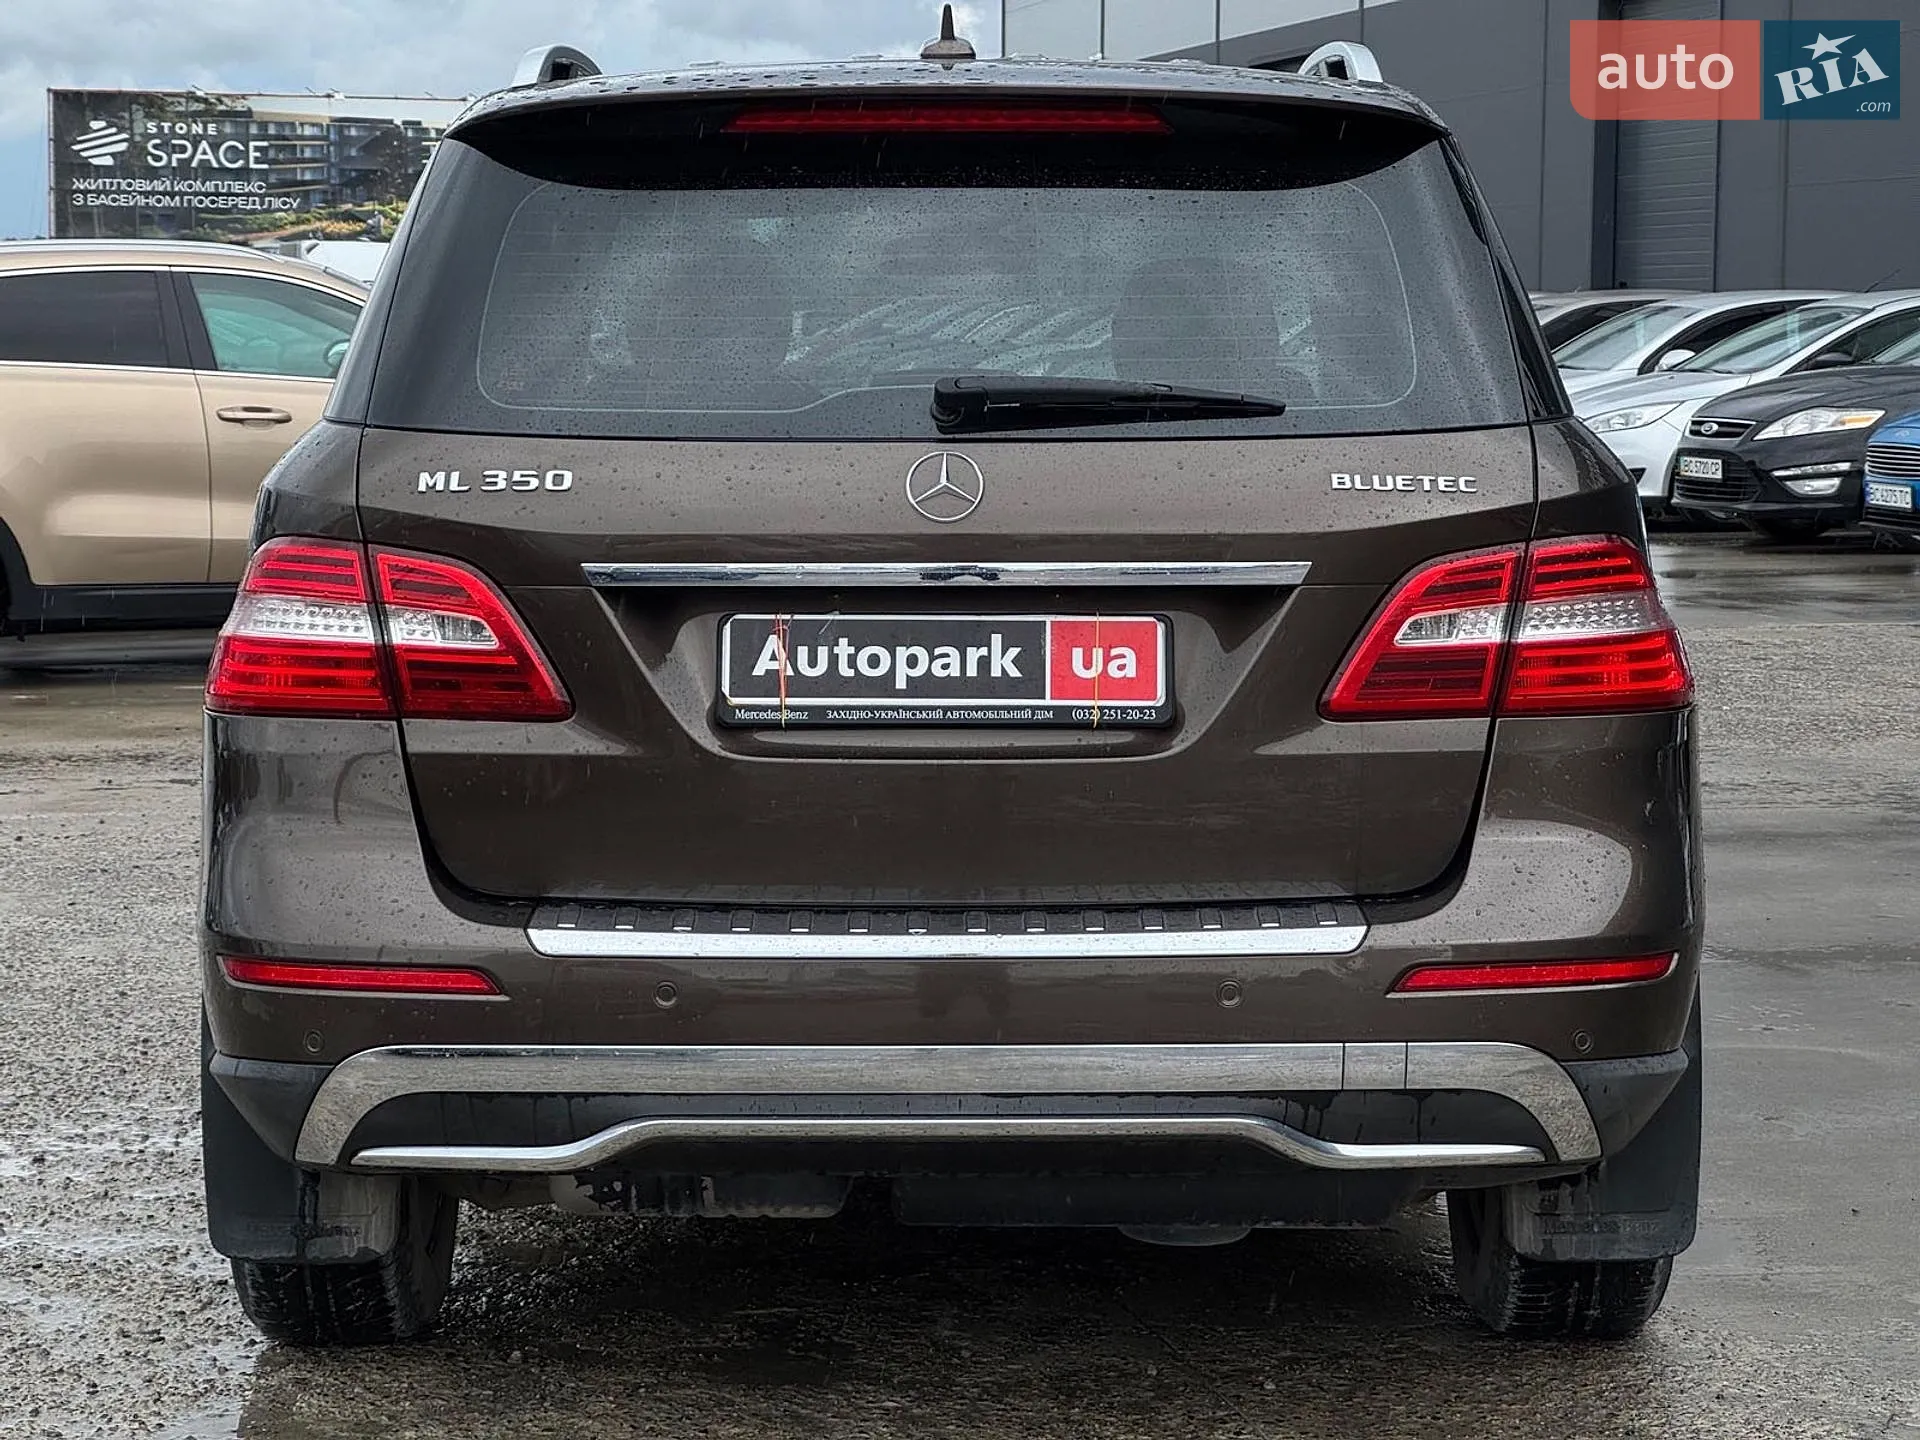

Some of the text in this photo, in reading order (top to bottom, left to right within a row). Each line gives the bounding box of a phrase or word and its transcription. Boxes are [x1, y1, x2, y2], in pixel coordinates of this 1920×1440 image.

[146, 121, 218, 136] STONE
[146, 139, 271, 169] SPACE
[72, 177, 268, 194] ЖИТЛОВИЙ КОМПЛЕКС
[87, 192, 180, 208] БАСЕЙНОМ
[183, 195, 261, 210] ПОСЕРЕД
[264, 196, 301, 210] ЛІСУ
[418, 470, 573, 493] ML 350
[1330, 473, 1478, 493] BLUETEC
[751, 633, 1137, 690] Autopark ua
[826, 707, 1054, 720] ЗАХІДНО-УКРАЇНСЬКИЙ АВТОМОБІЛЬНИЙ ДІМ
[1072, 708, 1157, 721] (032) 251-20-23
